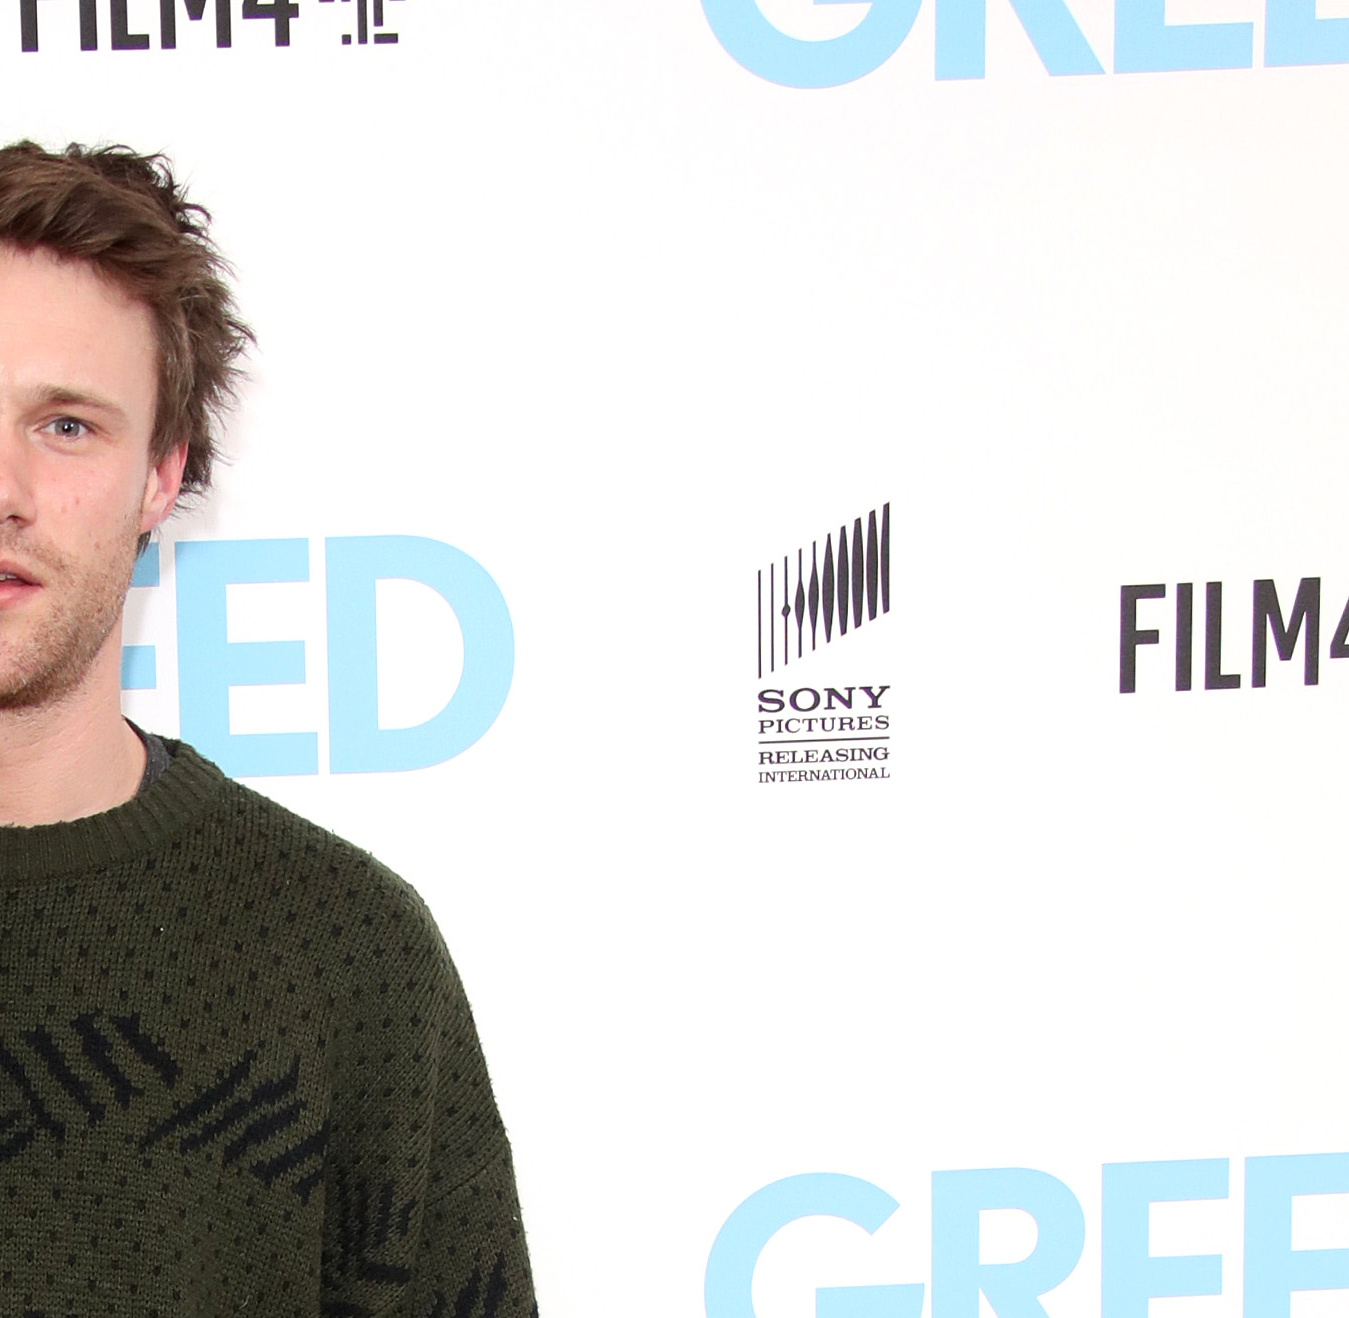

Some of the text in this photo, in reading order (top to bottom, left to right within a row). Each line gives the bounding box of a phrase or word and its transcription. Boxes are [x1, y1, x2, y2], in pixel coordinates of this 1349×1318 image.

[1119, 576, 1349, 694] FILM
[757, 685, 891, 713] SONY
[758, 714, 890, 734] PICTURES
[759, 746, 890, 765] RELEASING
[759, 767, 891, 783] INTERNATIONAL
